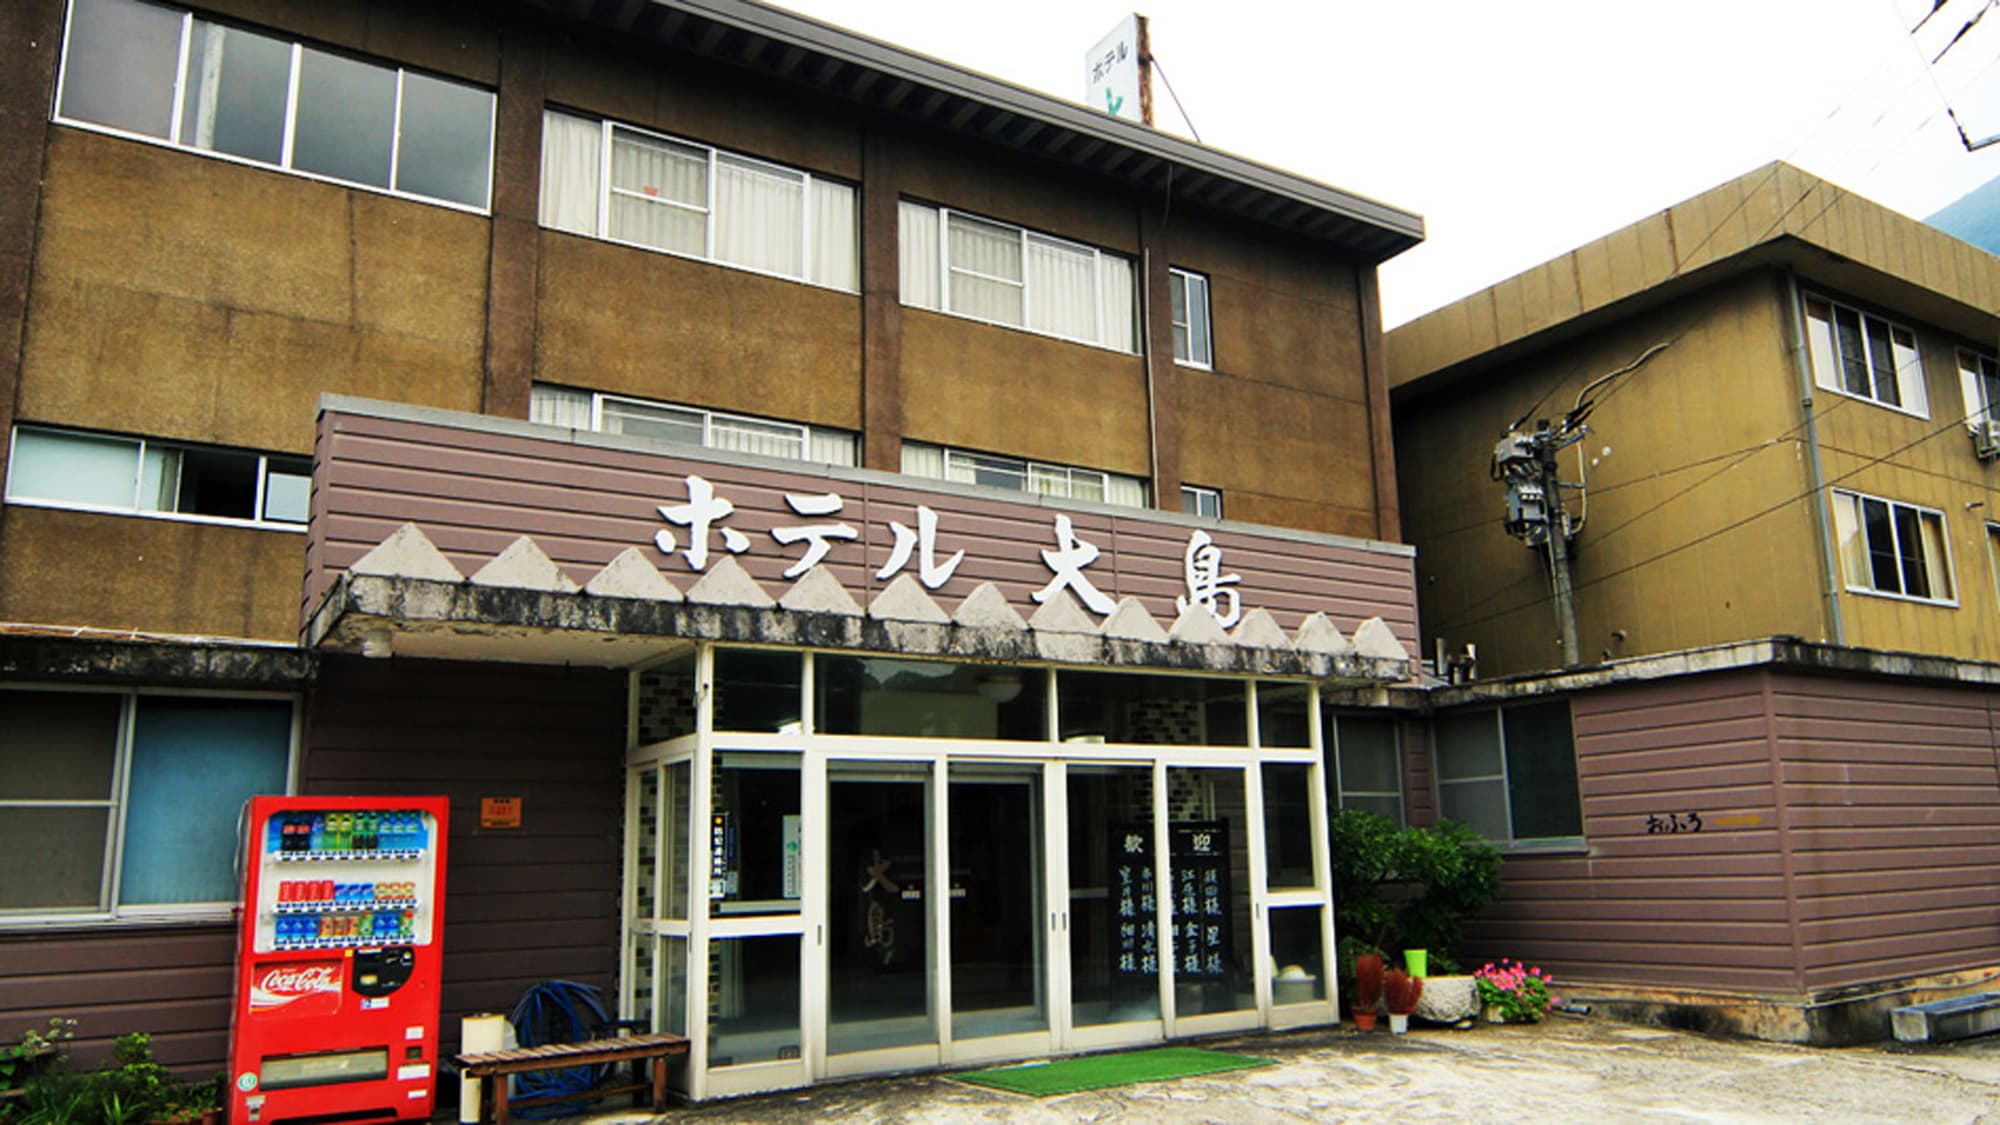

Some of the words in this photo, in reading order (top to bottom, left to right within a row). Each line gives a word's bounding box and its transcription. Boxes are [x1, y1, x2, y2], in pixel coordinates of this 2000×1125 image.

[1092, 41, 1128, 84] ホテル
[654, 475, 1242, 630] ホテル大島
